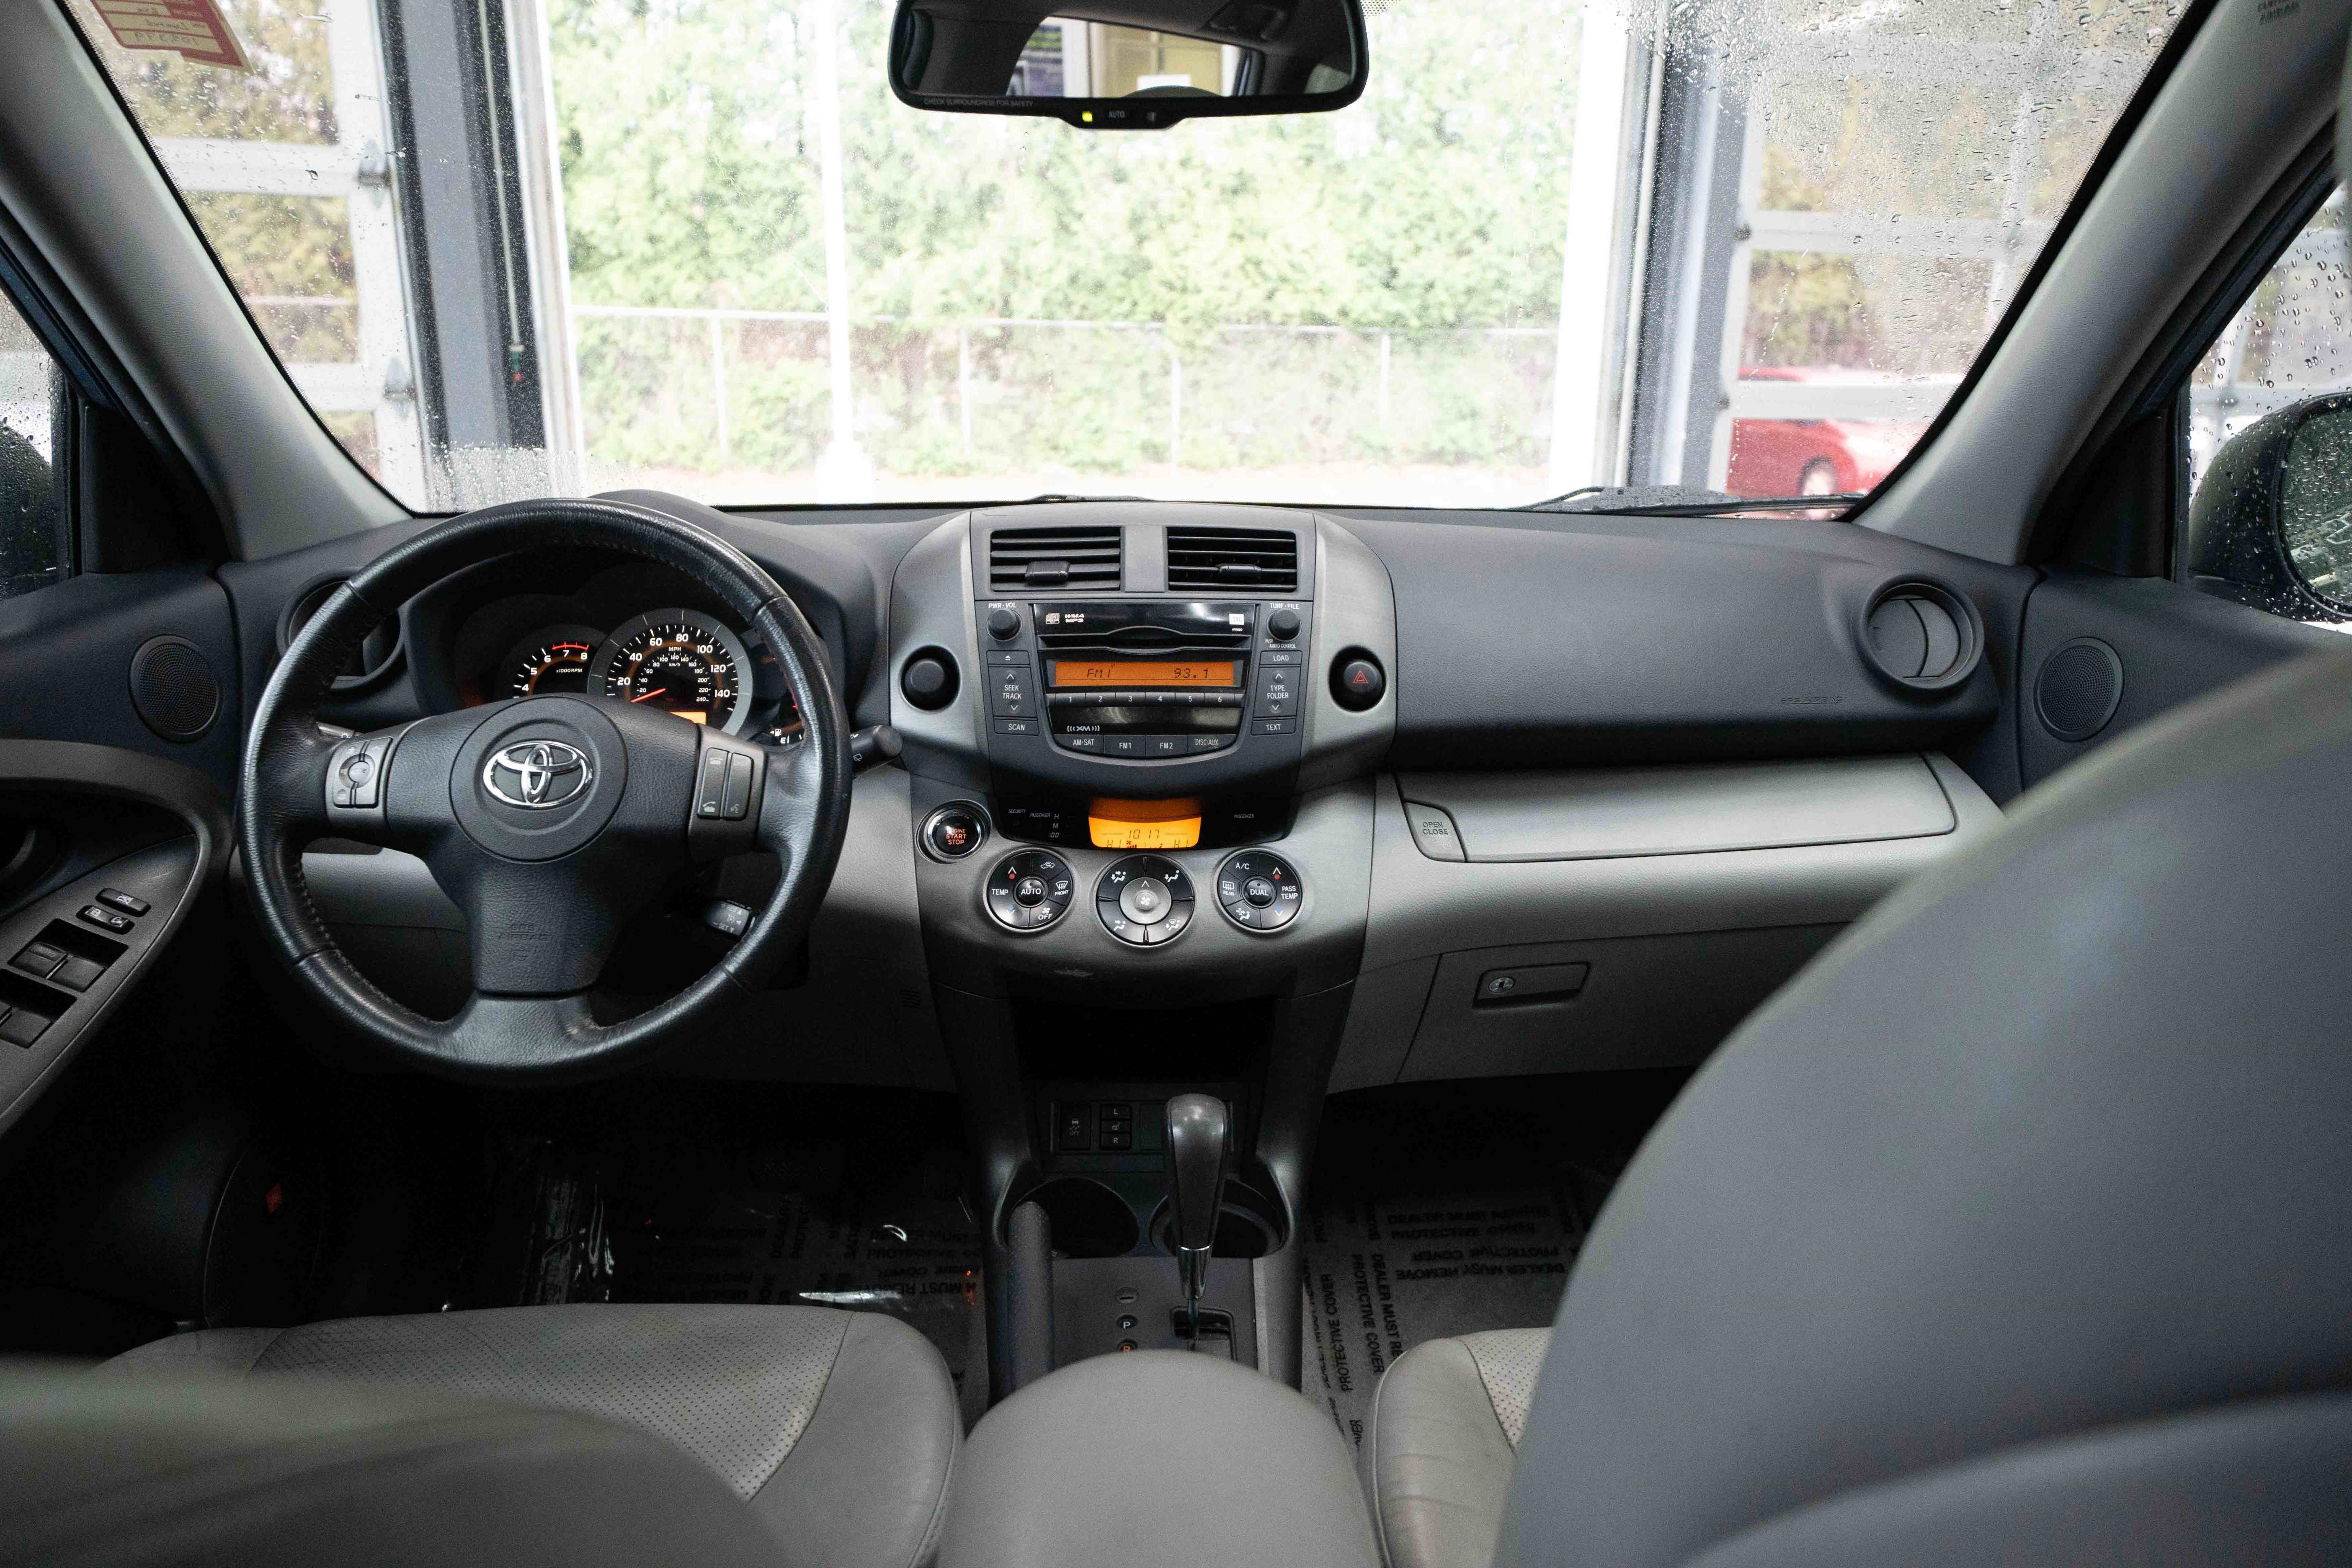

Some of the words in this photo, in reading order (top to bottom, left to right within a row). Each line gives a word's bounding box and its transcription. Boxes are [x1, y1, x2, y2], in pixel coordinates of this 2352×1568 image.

[649, 638, 662, 646] 60
[676, 633, 689, 642] 80
[697, 645, 713, 653] 100
[629, 653, 642, 661] 40
[710, 664, 726, 673] 120
[1173, 668, 1209, 679] 93.1
[617, 677, 631, 686] 20
[714, 689, 730, 698] 140
[1321, 1274, 1338, 1316] COVER
[1372, 1254, 1390, 1301] DEALER
[1381, 1303, 1399, 1339] MUST
[1352, 1254, 1375, 1328] PROTECTIVE
[1365, 1331, 1385, 1374] COVER
[1328, 1319, 1353, 1392] PROTECTIVE
